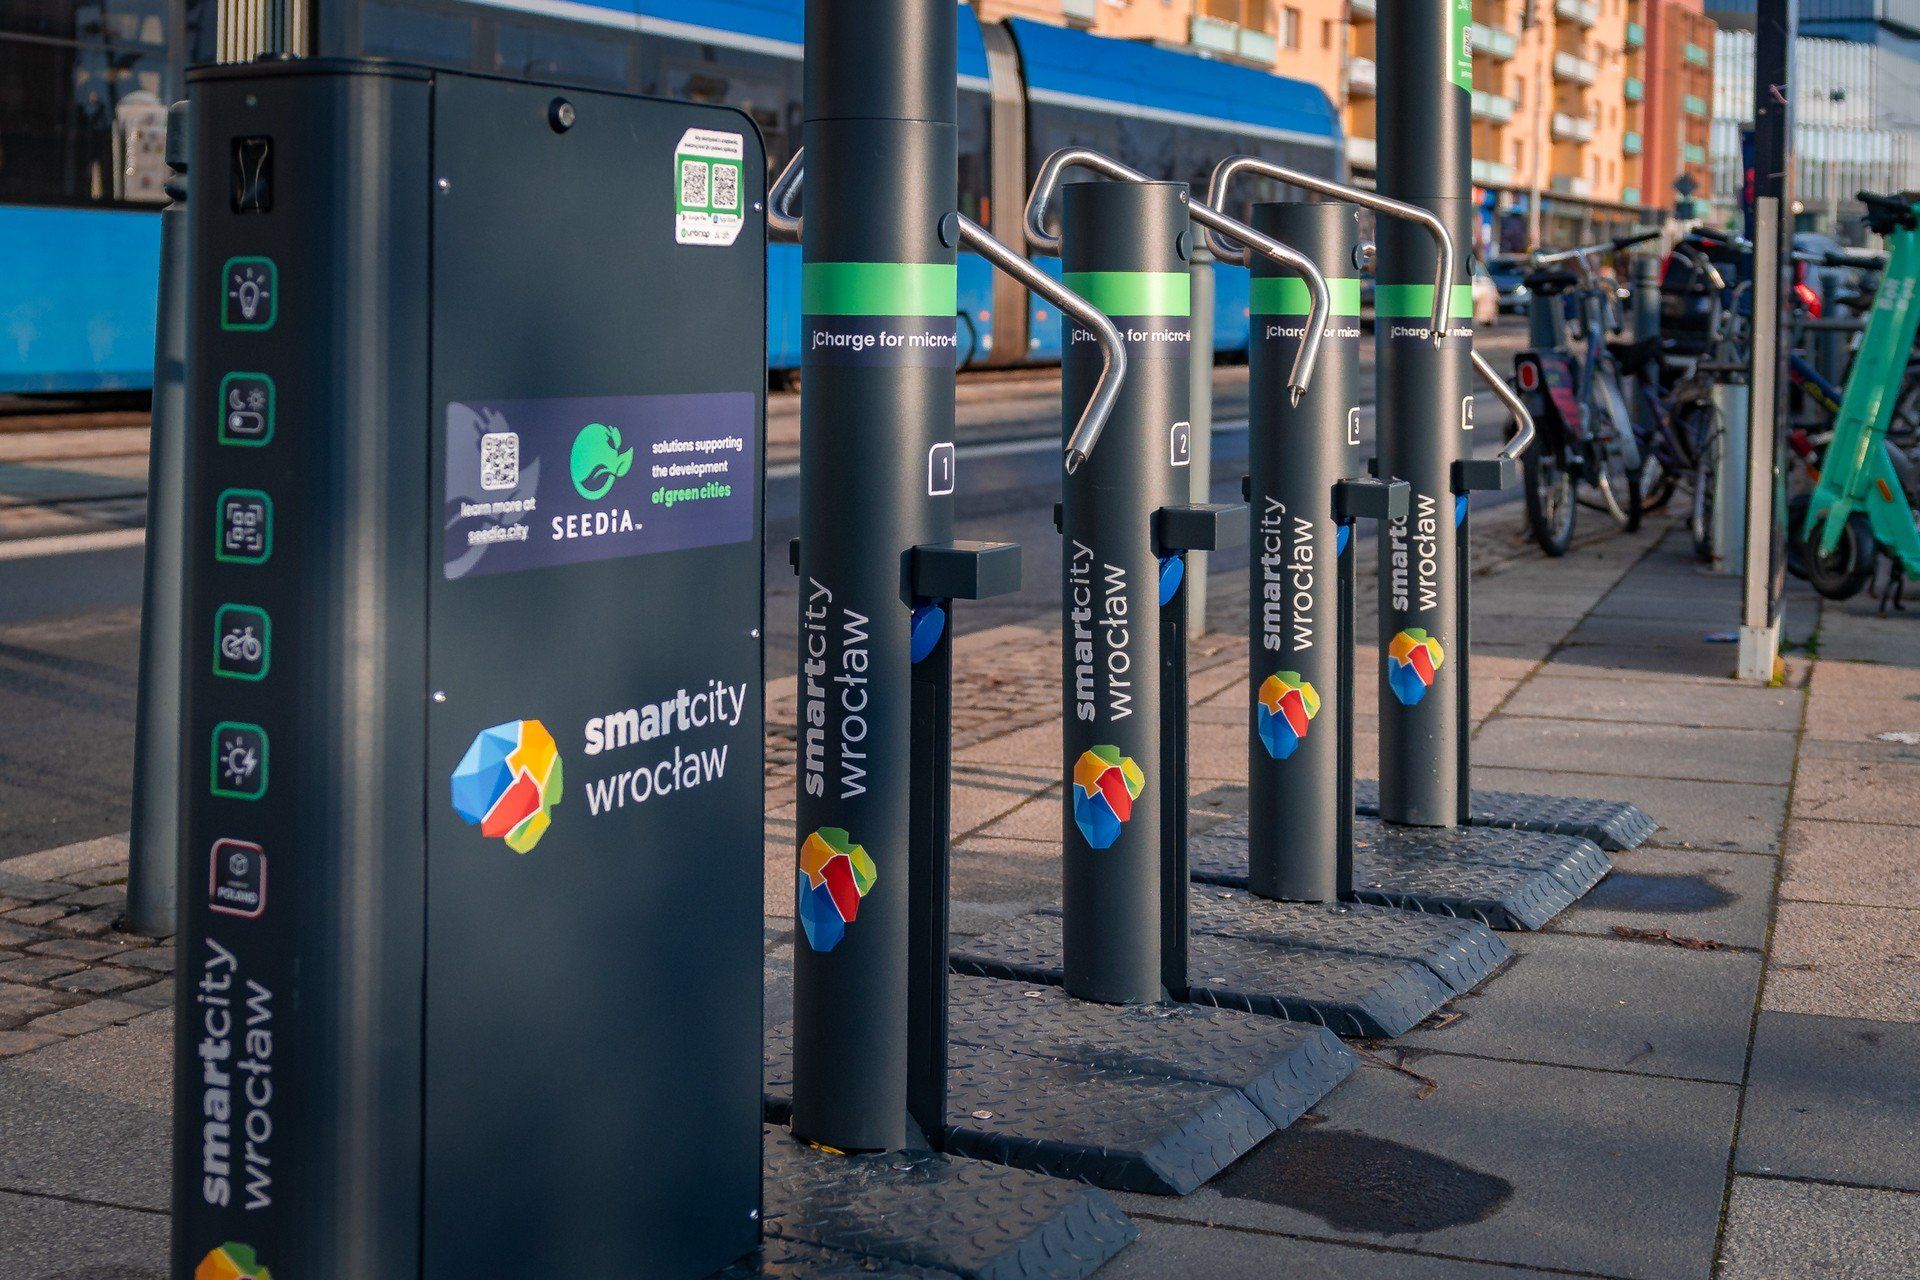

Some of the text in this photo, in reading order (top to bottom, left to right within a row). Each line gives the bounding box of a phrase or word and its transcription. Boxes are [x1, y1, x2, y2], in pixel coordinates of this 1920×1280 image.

[812, 330, 875, 351] jCharge
[879, 331, 904, 347] for
[1127, 328, 1148, 342] for
[1323, 328, 1336, 337] or
[652, 436, 742, 454] solutions supporting
[1180, 433, 1187, 454] 2
[1354, 417, 1360, 435] 3
[651, 481, 731, 508] of green cities
[652, 460, 728, 478] the development
[942, 456, 948, 480] 1
[1260, 495, 1286, 652] smartcity
[1287, 516, 1314, 652] wrocław
[1412, 493, 1438, 612] wrocław
[1070, 539, 1096, 722] smartcity
[1099, 563, 1133, 722] wrocław
[584, 679, 747, 756] smartcity
[804, 576, 833, 798] smartcity
[834, 608, 869, 800] wrocław
[585, 744, 728, 817] wrocław
[197, 937, 239, 1208] smartcity
[236, 978, 273, 1211] wrocław
